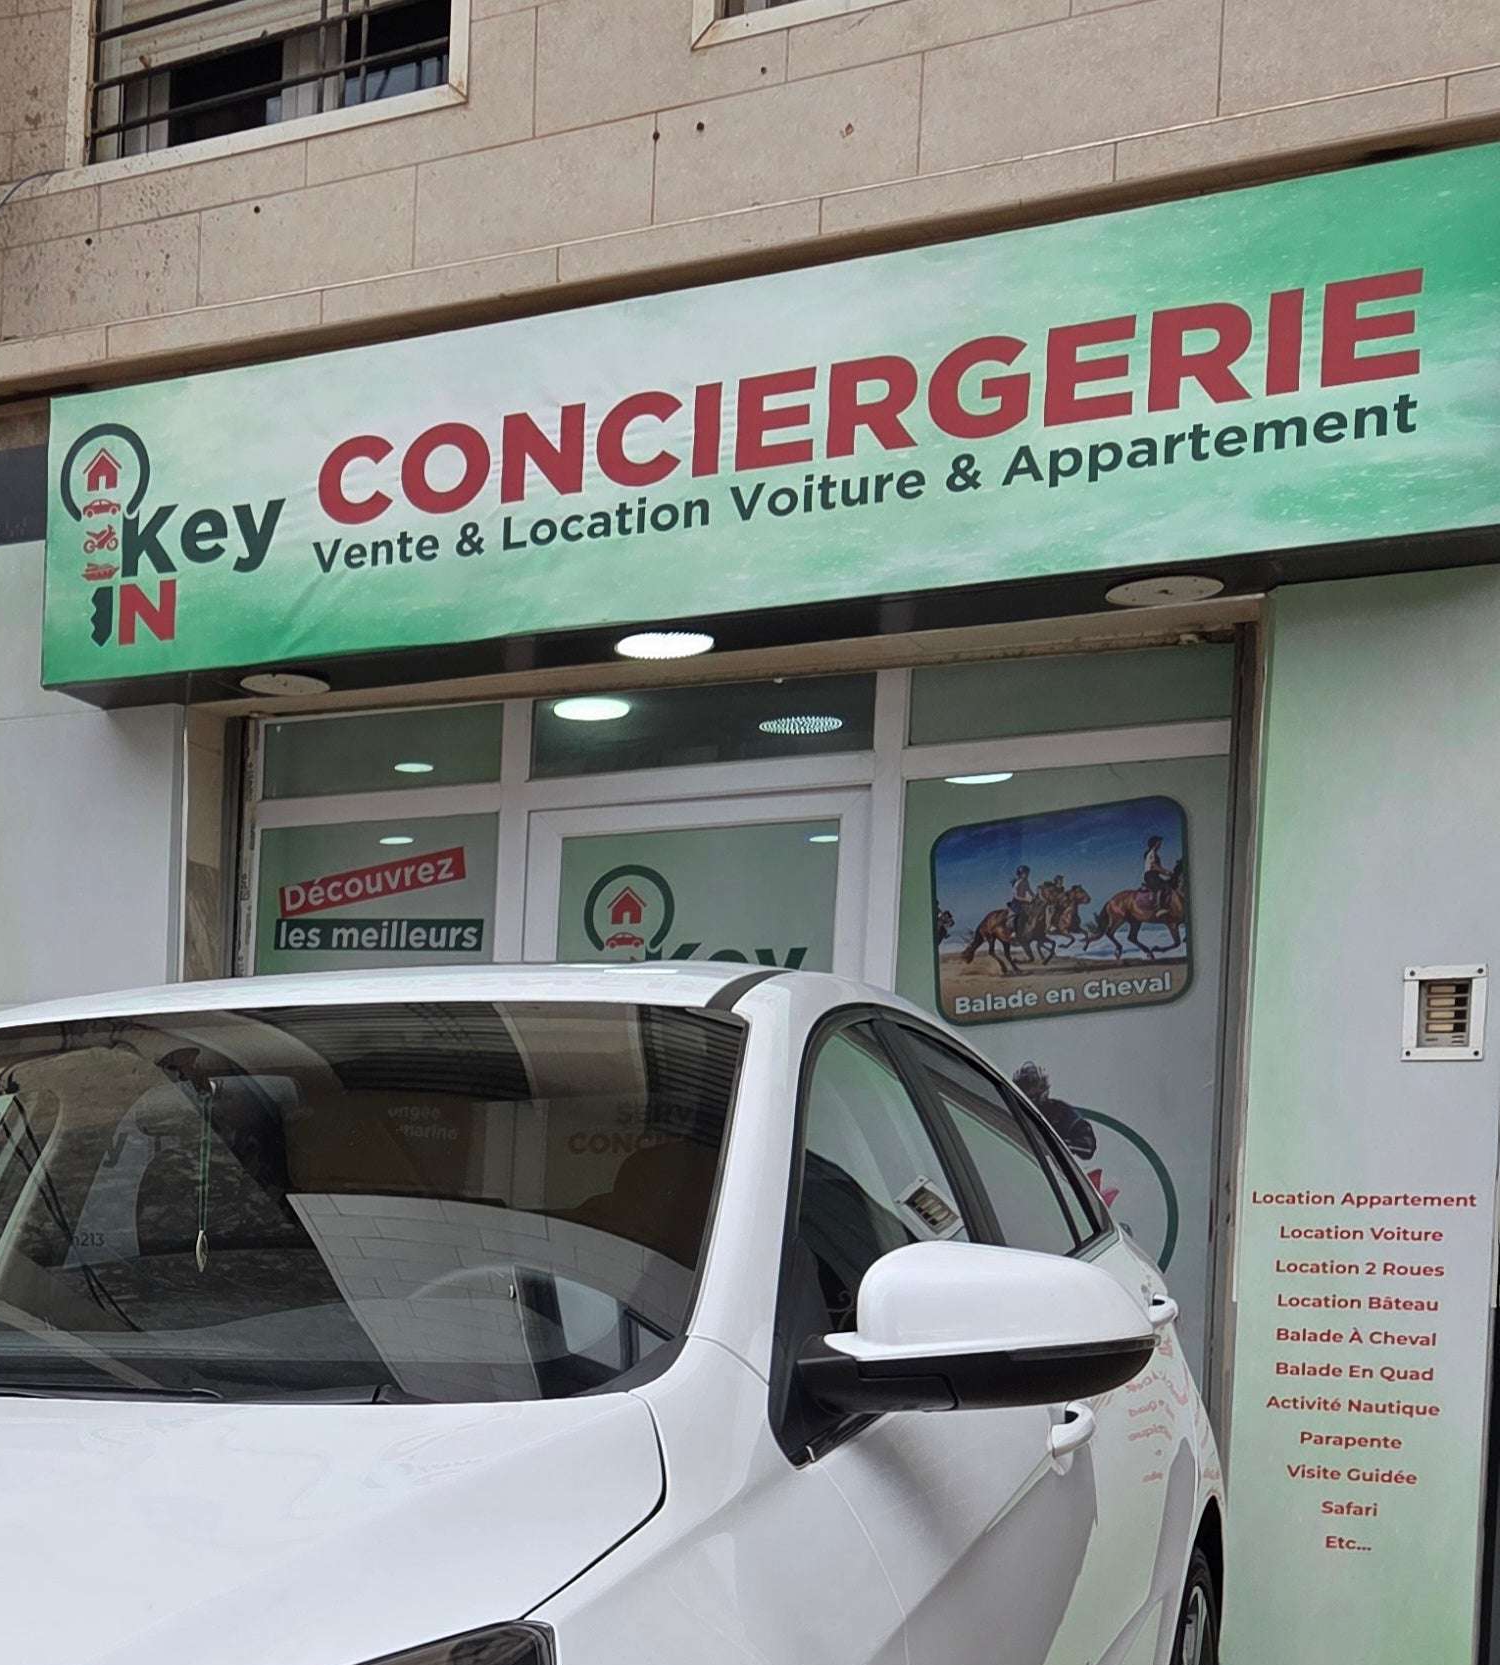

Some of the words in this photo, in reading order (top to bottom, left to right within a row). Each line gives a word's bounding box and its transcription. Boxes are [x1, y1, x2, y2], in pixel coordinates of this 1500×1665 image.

[318, 267, 1424, 525] CONCIERGERIE
[312, 531, 440, 574] Vente
[455, 521, 486, 558] &
[502, 490, 711, 552] Location
[731, 467, 926, 523] Voiture
[945, 453, 981, 493] &
[1002, 394, 1418, 489] Appartement
[120, 497, 287, 579] Key
[285, 857, 454, 912] Découvrez
[280, 922, 321, 949] les
[331, 920, 477, 950] meilleurs
[955, 992, 1037, 1015] Balade
[1046, 987, 1075, 1004] en
[1083, 971, 1172, 999] Cheval
[1252, 1191, 1335, 1206] Location
[1341, 1192, 1477, 1209] Appartement
[1280, 1226, 1364, 1241] Location
[1370, 1227, 1444, 1242] Voiture
[1275, 1260, 1359, 1275] Location
[1365, 1262, 1376, 1275] 2
[1383, 1263, 1445, 1277] Roues
[1277, 1294, 1361, 1309] Location
[1368, 1296, 1439, 1311] Bâteau
[1276, 1328, 1343, 1343] Balade
[1348, 1327, 1363, 1344] À
[1369, 1331, 1437, 1347] Cheval
[1275, 1362, 1342, 1377] Balade
[1348, 1365, 1374, 1379] En
[1380, 1366, 1434, 1382] Quad
[1266, 1395, 1341, 1411] Activité
[1347, 1399, 1440, 1418] Nautique
[1300, 1431, 1402, 1450] Parapente
[1287, 1464, 1341, 1480] Visite
[1347, 1467, 1418, 1484] Guidée
[1321, 1501, 1378, 1517] Safari
[1325, 1535, 1372, 1551] Etc...
